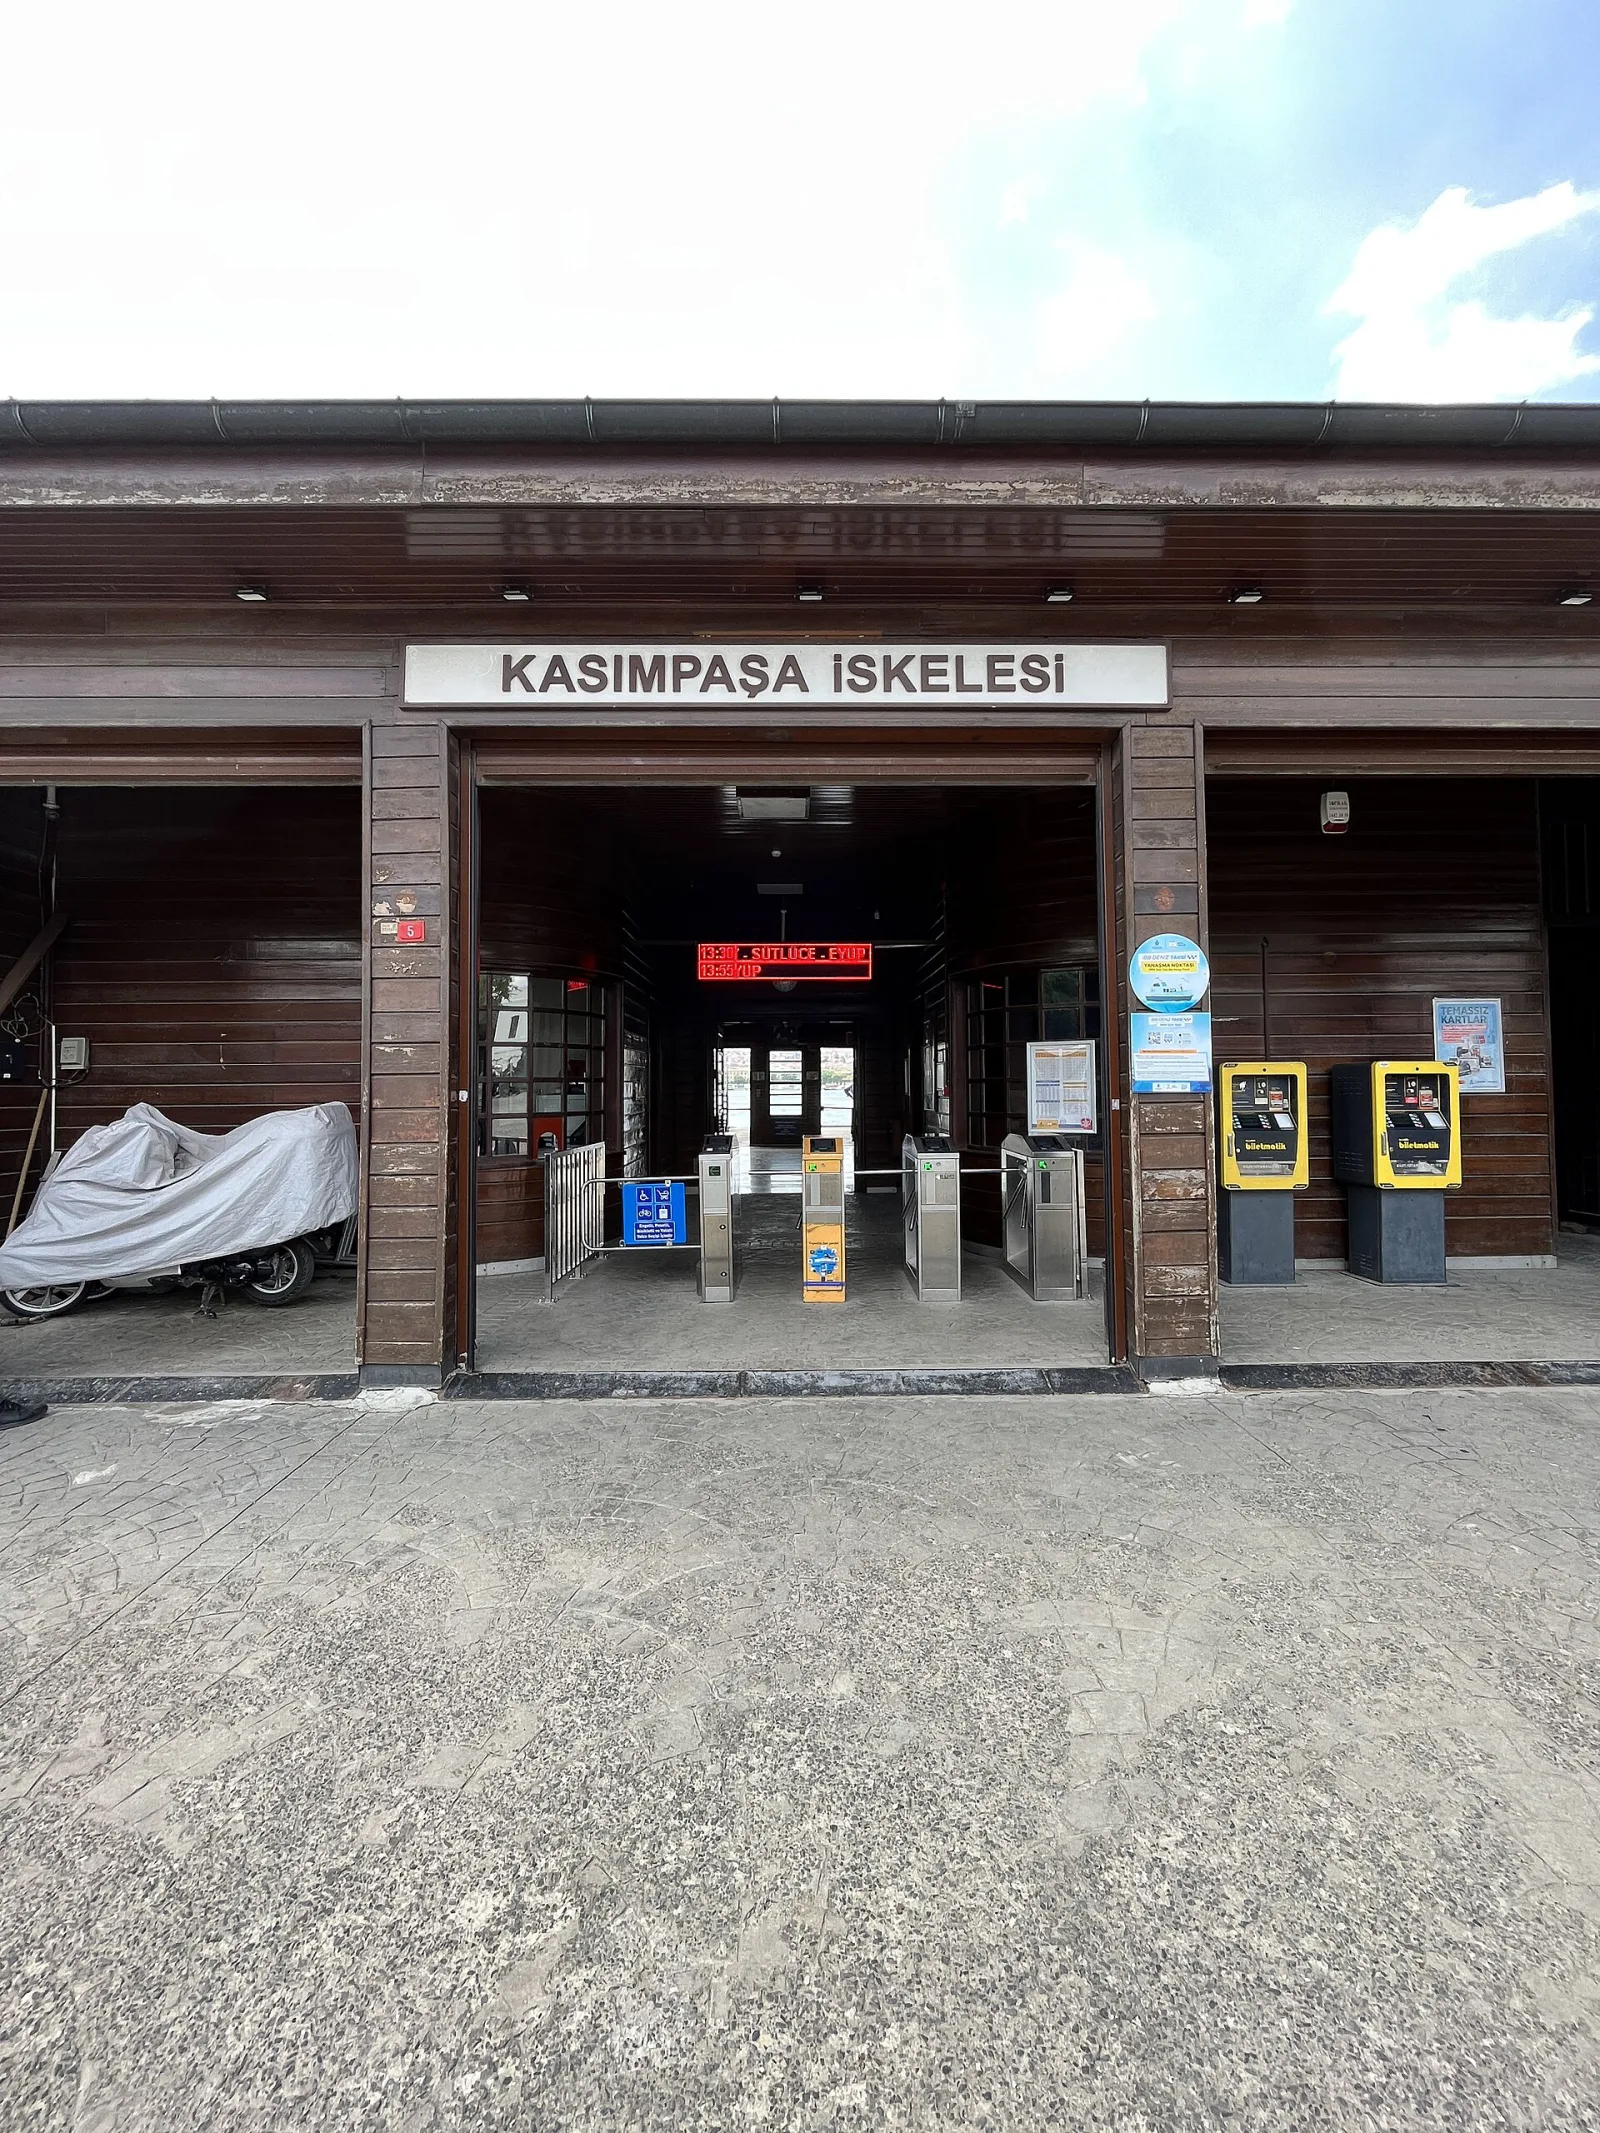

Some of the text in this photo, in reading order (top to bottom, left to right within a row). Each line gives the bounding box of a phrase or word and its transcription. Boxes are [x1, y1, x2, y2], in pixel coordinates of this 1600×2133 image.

[501, 654, 809, 698] KASIMPAŞA
[407, 925, 414, 937] 5
[700, 946, 733, 960] 13:30
[751, 945, 816, 960] SÜTLÜCE
[828, 946, 866, 960] EYÜP
[700, 964, 733, 977] 13:55
[1440, 1006, 1489, 1015] TEMASSIZ
[1441, 1015, 1487, 1024] KARTLAR
[1245, 1142, 1287, 1150] biletmatik
[1398, 1141, 1440, 1149] biletmatik
